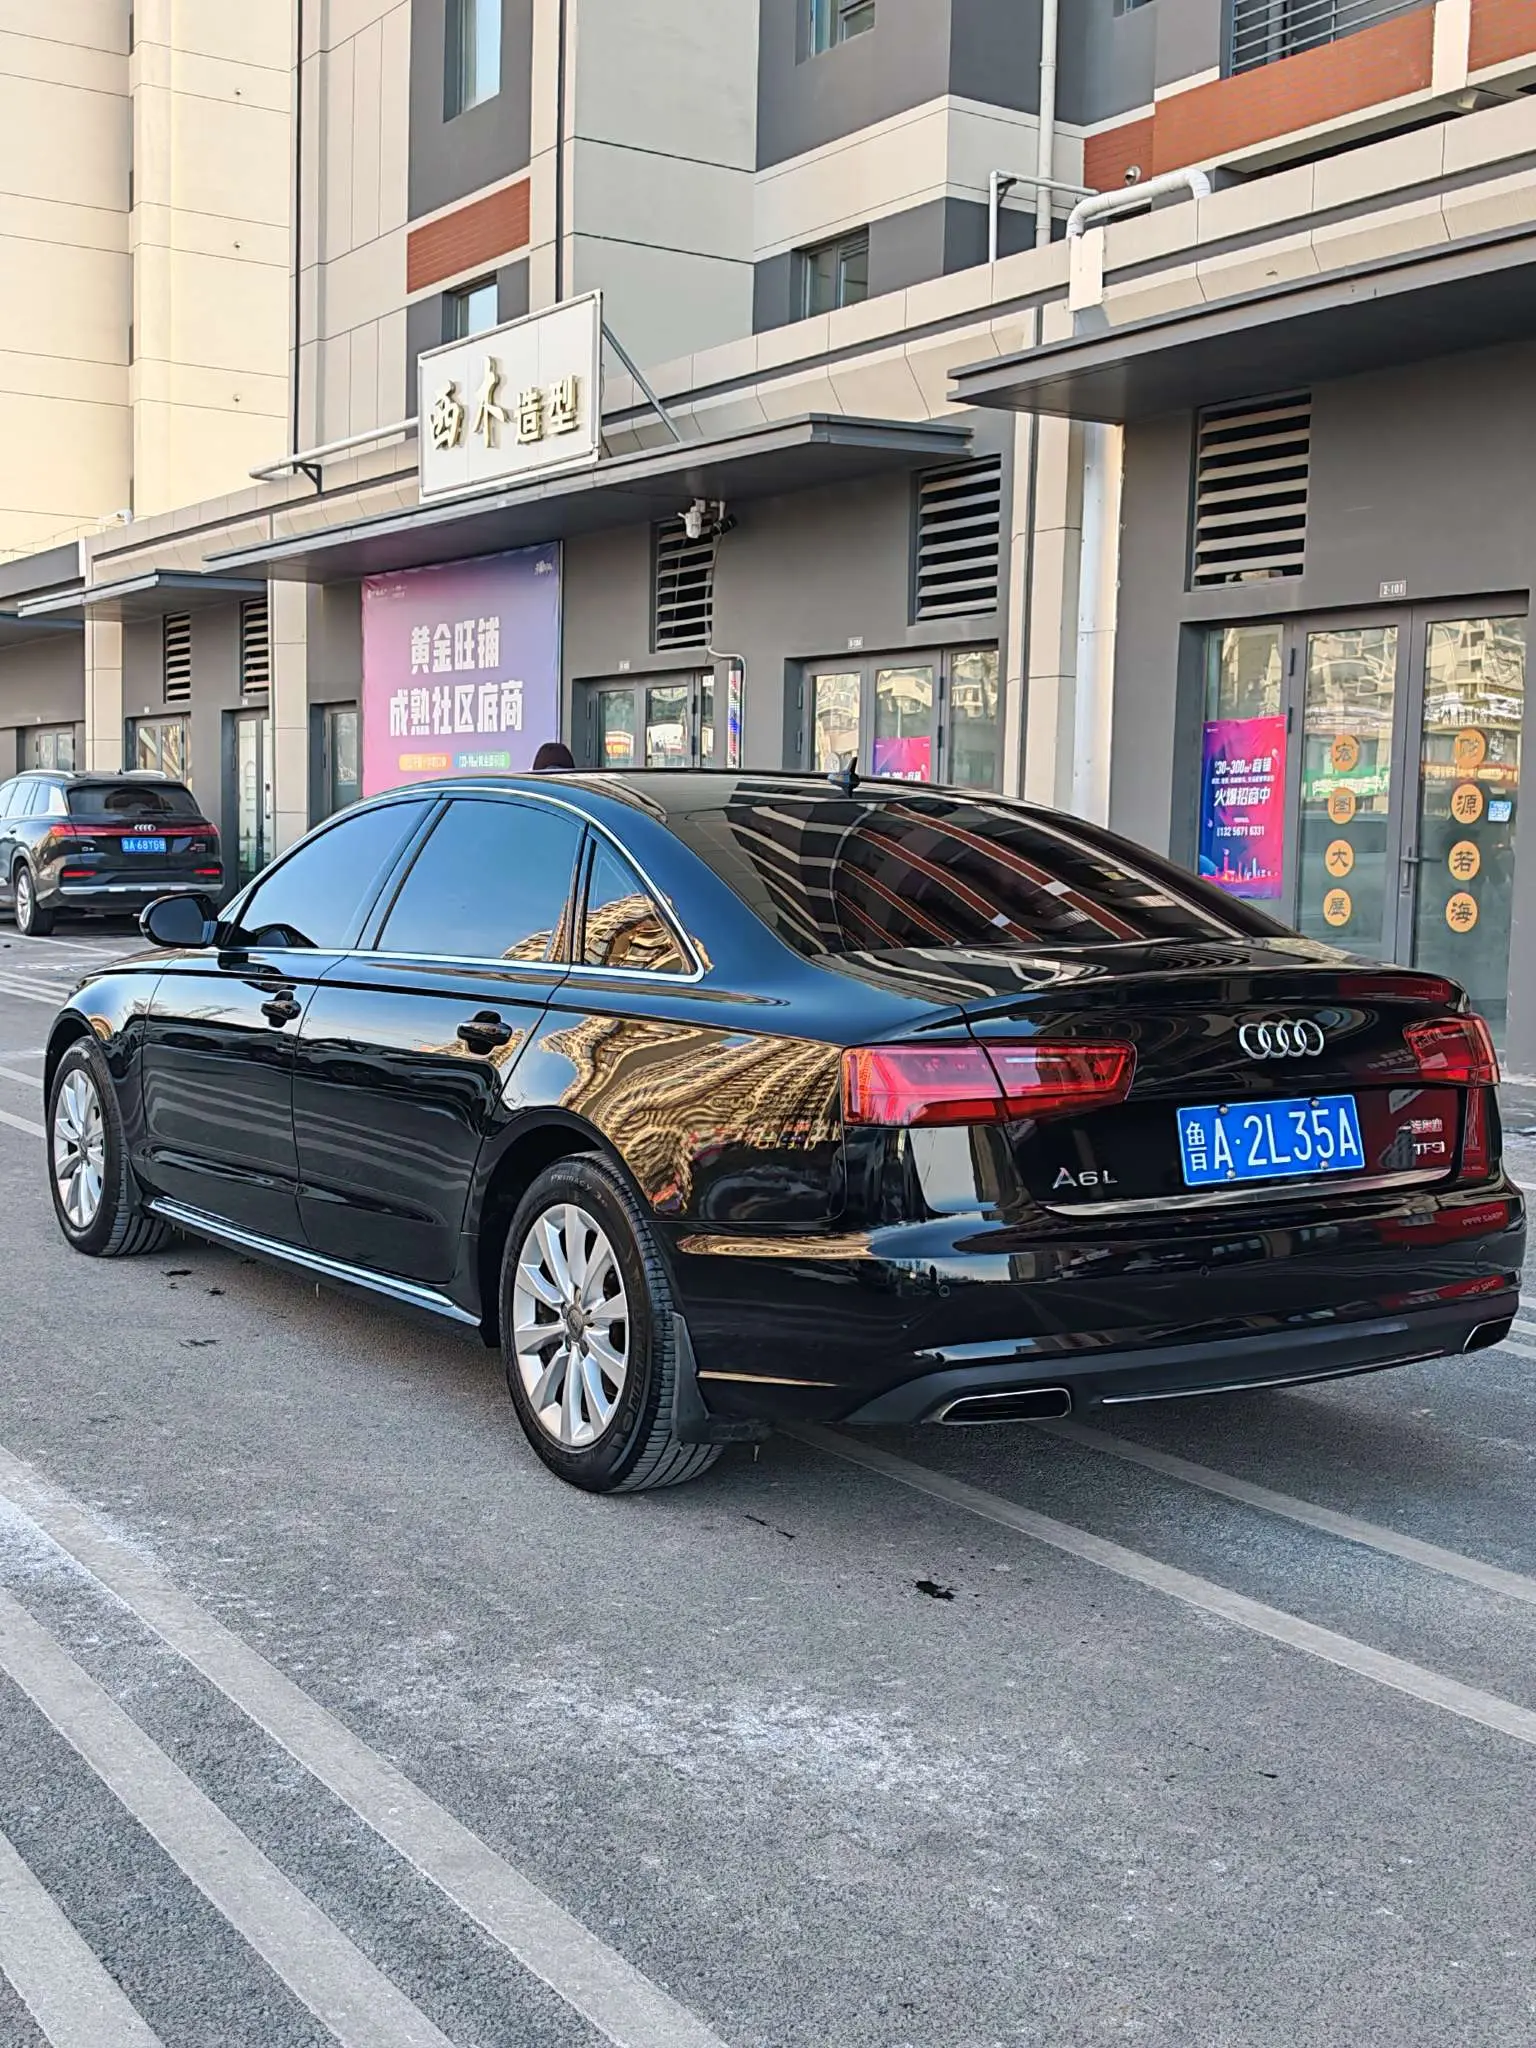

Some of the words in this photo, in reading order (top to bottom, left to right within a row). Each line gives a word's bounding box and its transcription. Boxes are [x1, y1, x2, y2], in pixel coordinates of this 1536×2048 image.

[411, 616, 499, 675] 黄金旺铺
[389, 679, 523, 737] 成熟社区底商
[1214, 787, 1270, 806] 火爆招商中
[1185, 1107, 1359, 1171] 鲁A·2L35A
[1412, 1140, 1446, 1155] TFSI
[1052, 1167, 1119, 1190] A6L
